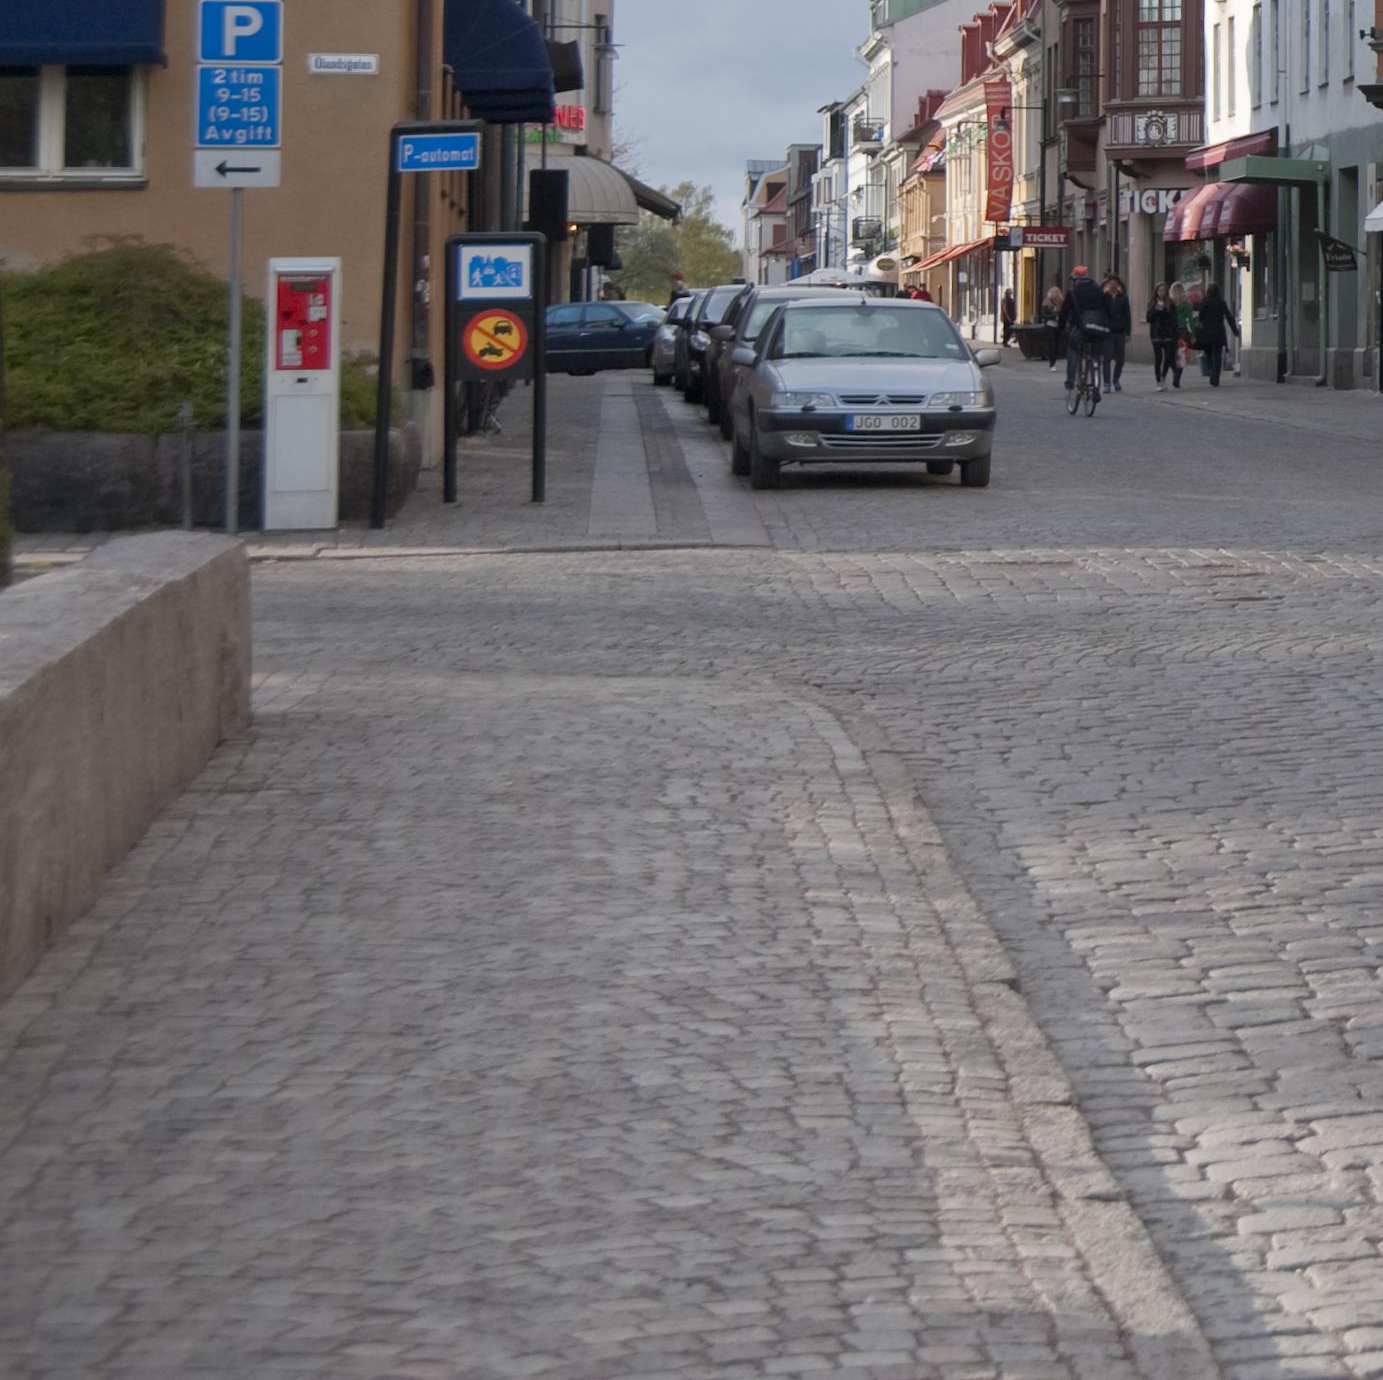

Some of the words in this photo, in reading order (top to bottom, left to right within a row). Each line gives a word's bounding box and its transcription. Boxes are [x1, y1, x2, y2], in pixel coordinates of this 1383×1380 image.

[223, 5, 264, 57] P
[212, 69, 227, 84] 2
[231, 69, 264, 84] tim
[216, 87, 262, 102] 9-15
[208, 105, 269, 123] (9-15)
[205, 125, 273, 144] Avgift
[403, 143, 475, 163] P-automat
[1120, 189, 1187, 215] TICK
[1025, 233, 1067, 243] TICKET
[855, 416, 882, 429] JGO
[891, 416, 919, 429] 002
